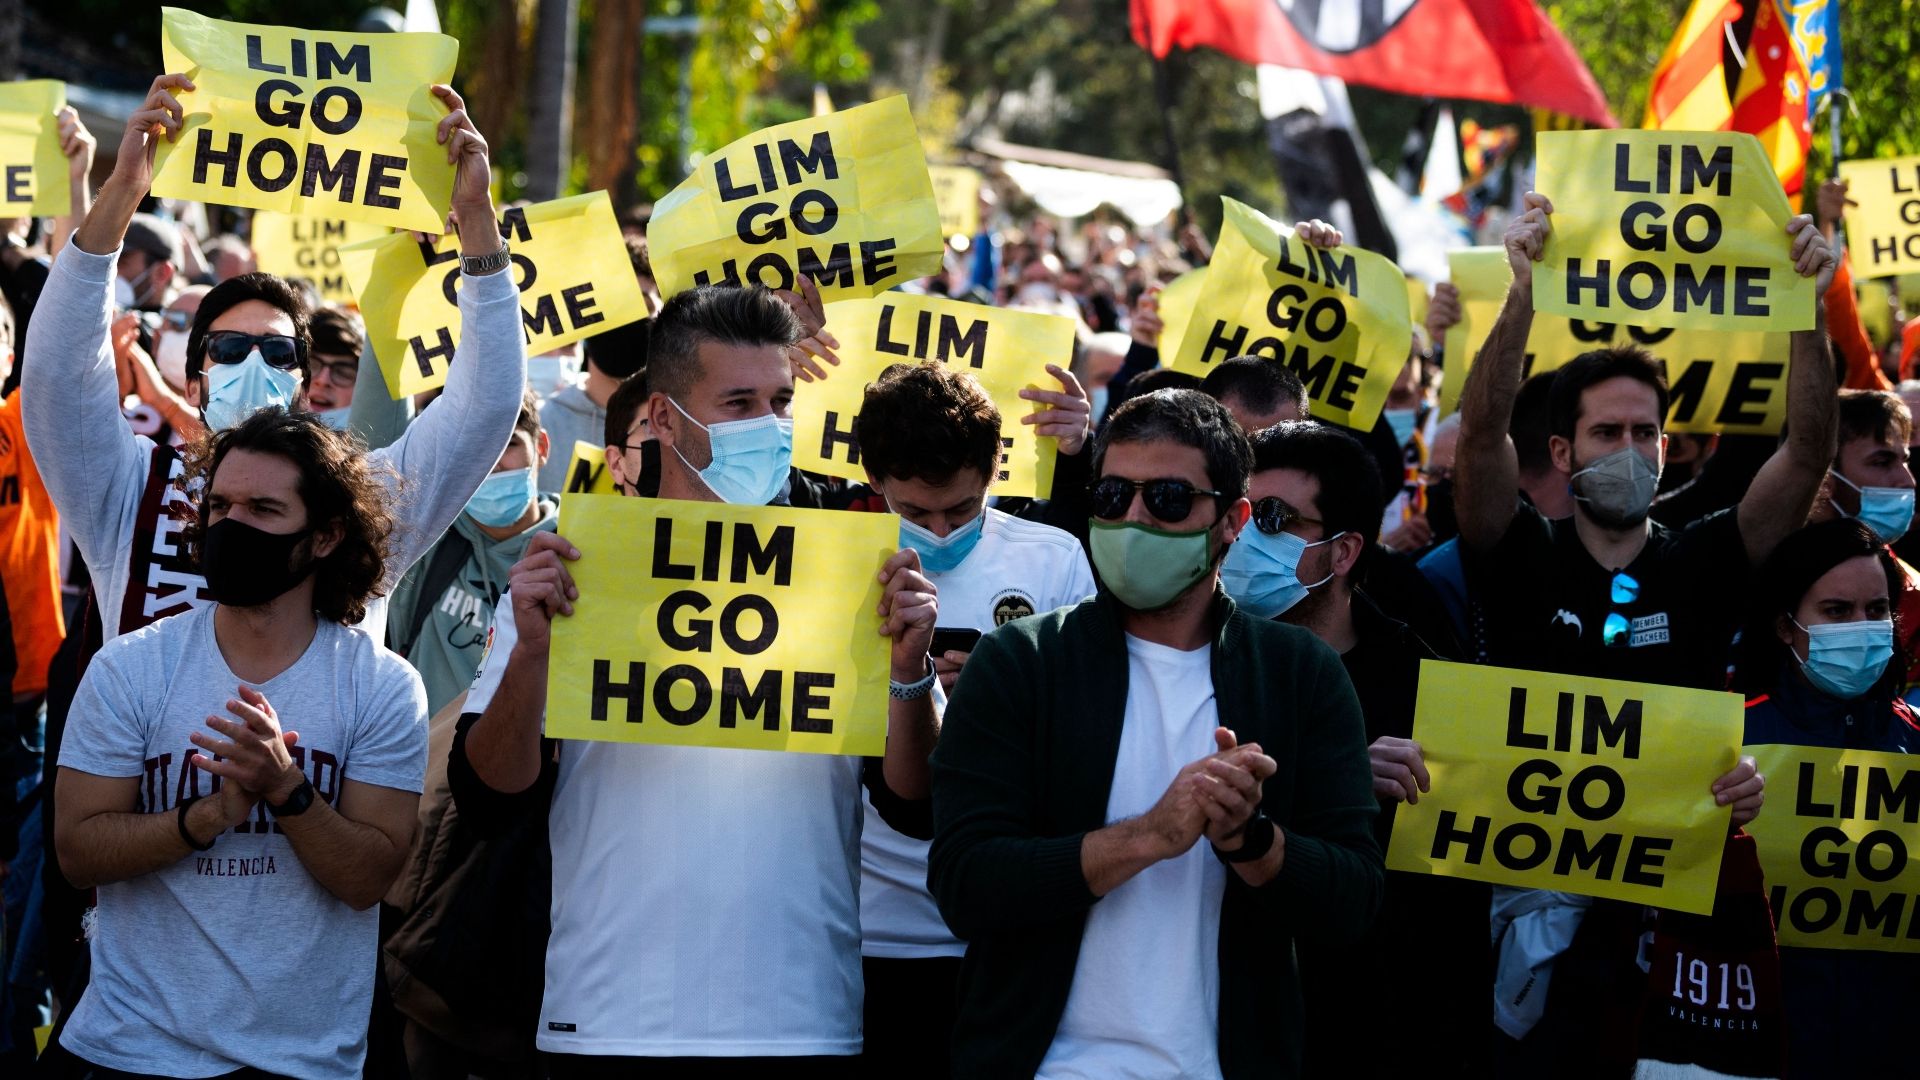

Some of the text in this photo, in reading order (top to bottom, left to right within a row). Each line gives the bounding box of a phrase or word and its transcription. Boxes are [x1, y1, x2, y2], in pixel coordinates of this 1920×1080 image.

[246, 34, 371, 83] LIM
[255, 79, 362, 135] GO
[192, 128, 408, 210] HOME
[714, 130, 839, 202] LIM
[1614, 143, 1733, 196] LIM
[293, 219, 345, 241] LIM
[736, 189, 839, 244] GO
[1620, 201, 1722, 254] GO
[296, 247, 341, 268] GO
[1277, 234, 1358, 298] LIM
[1266, 284, 1347, 343] GO
[1567, 257, 1771, 317] HOME
[409, 282, 605, 378] HME
[875, 304, 989, 369] LIM
[652, 517, 795, 586] LIM
[441, 586, 483, 629] HOL
[448, 612, 487, 649] Ca
[656, 590, 779, 655] GO
[1633, 615, 1665, 629] MEMBER
[591, 659, 835, 734] HOME
[1506, 686, 1643, 759] LIM
[1506, 759, 1626, 821] GO
[1796, 761, 1920, 823] LIM
[197, 856, 276, 876] VALENCIA
[1430, 809, 1674, 888] HOME
[1800, 826, 1908, 882] GO
[1672, 952, 1756, 1010] 1919
[1670, 1005, 1758, 1030] VALENCIA
